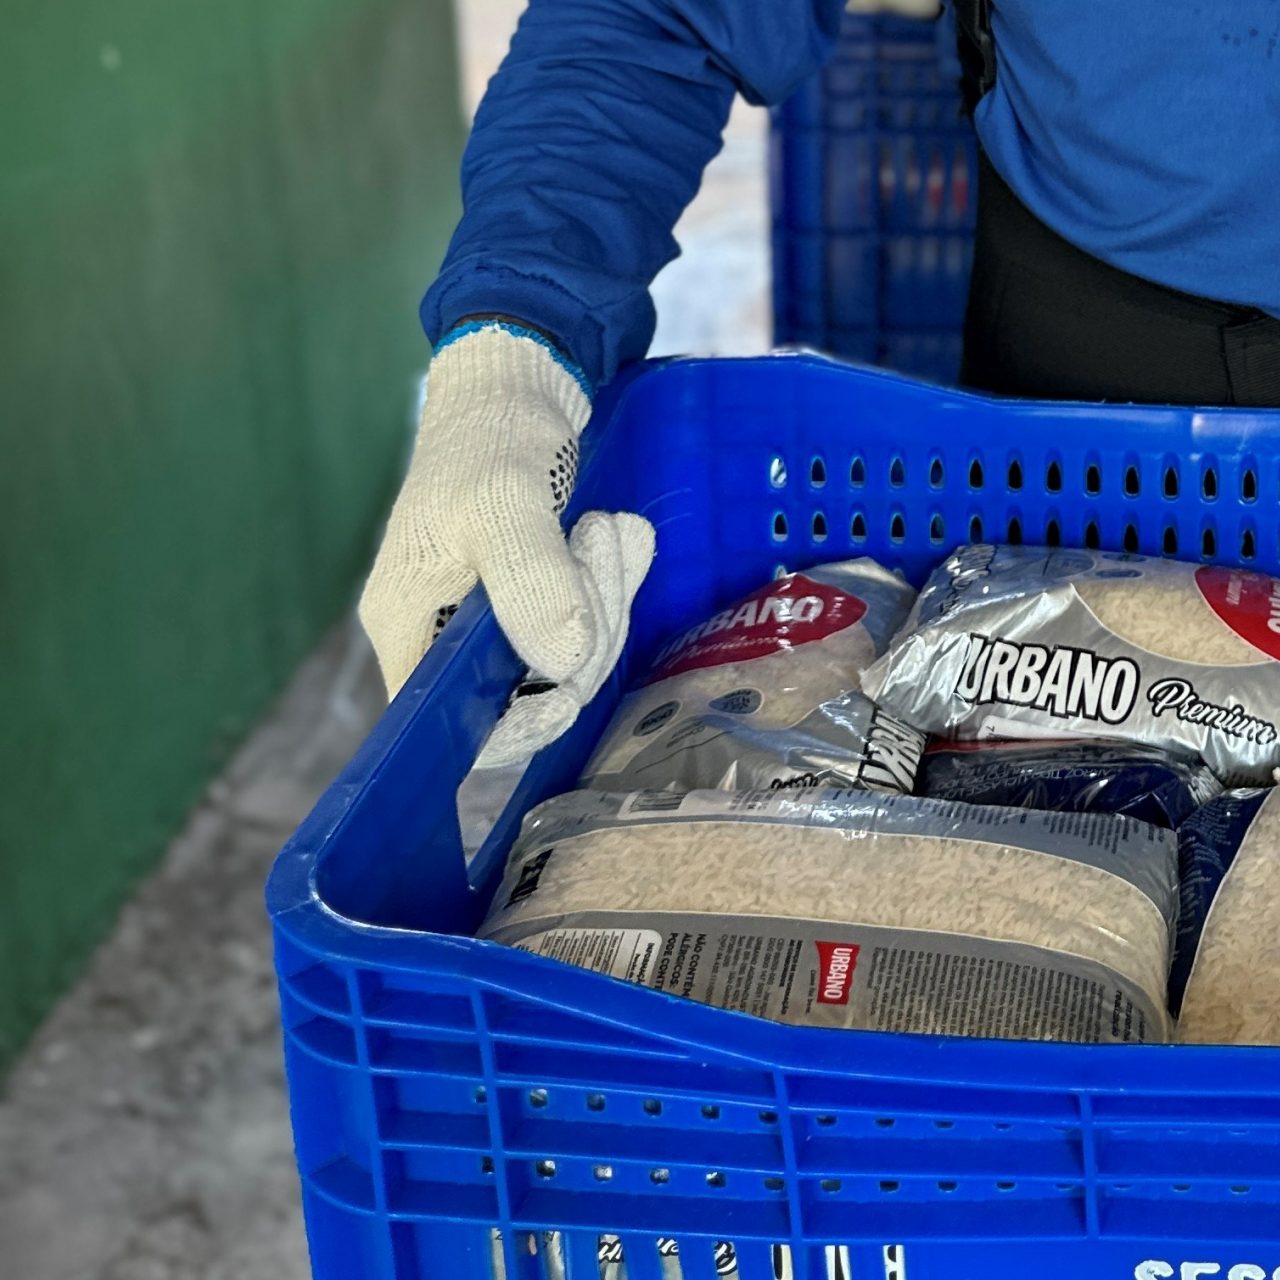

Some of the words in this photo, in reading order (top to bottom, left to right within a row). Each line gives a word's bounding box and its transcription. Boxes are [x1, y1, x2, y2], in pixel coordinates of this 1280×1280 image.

[651, 596, 823, 667] URBANO
[957, 632, 1140, 724] URBANO
[1147, 677, 1278, 746] Premium
[663, 931, 680, 957] PODE
[693, 932, 707, 954] NÃO
[823, 947, 853, 999] URBANO
